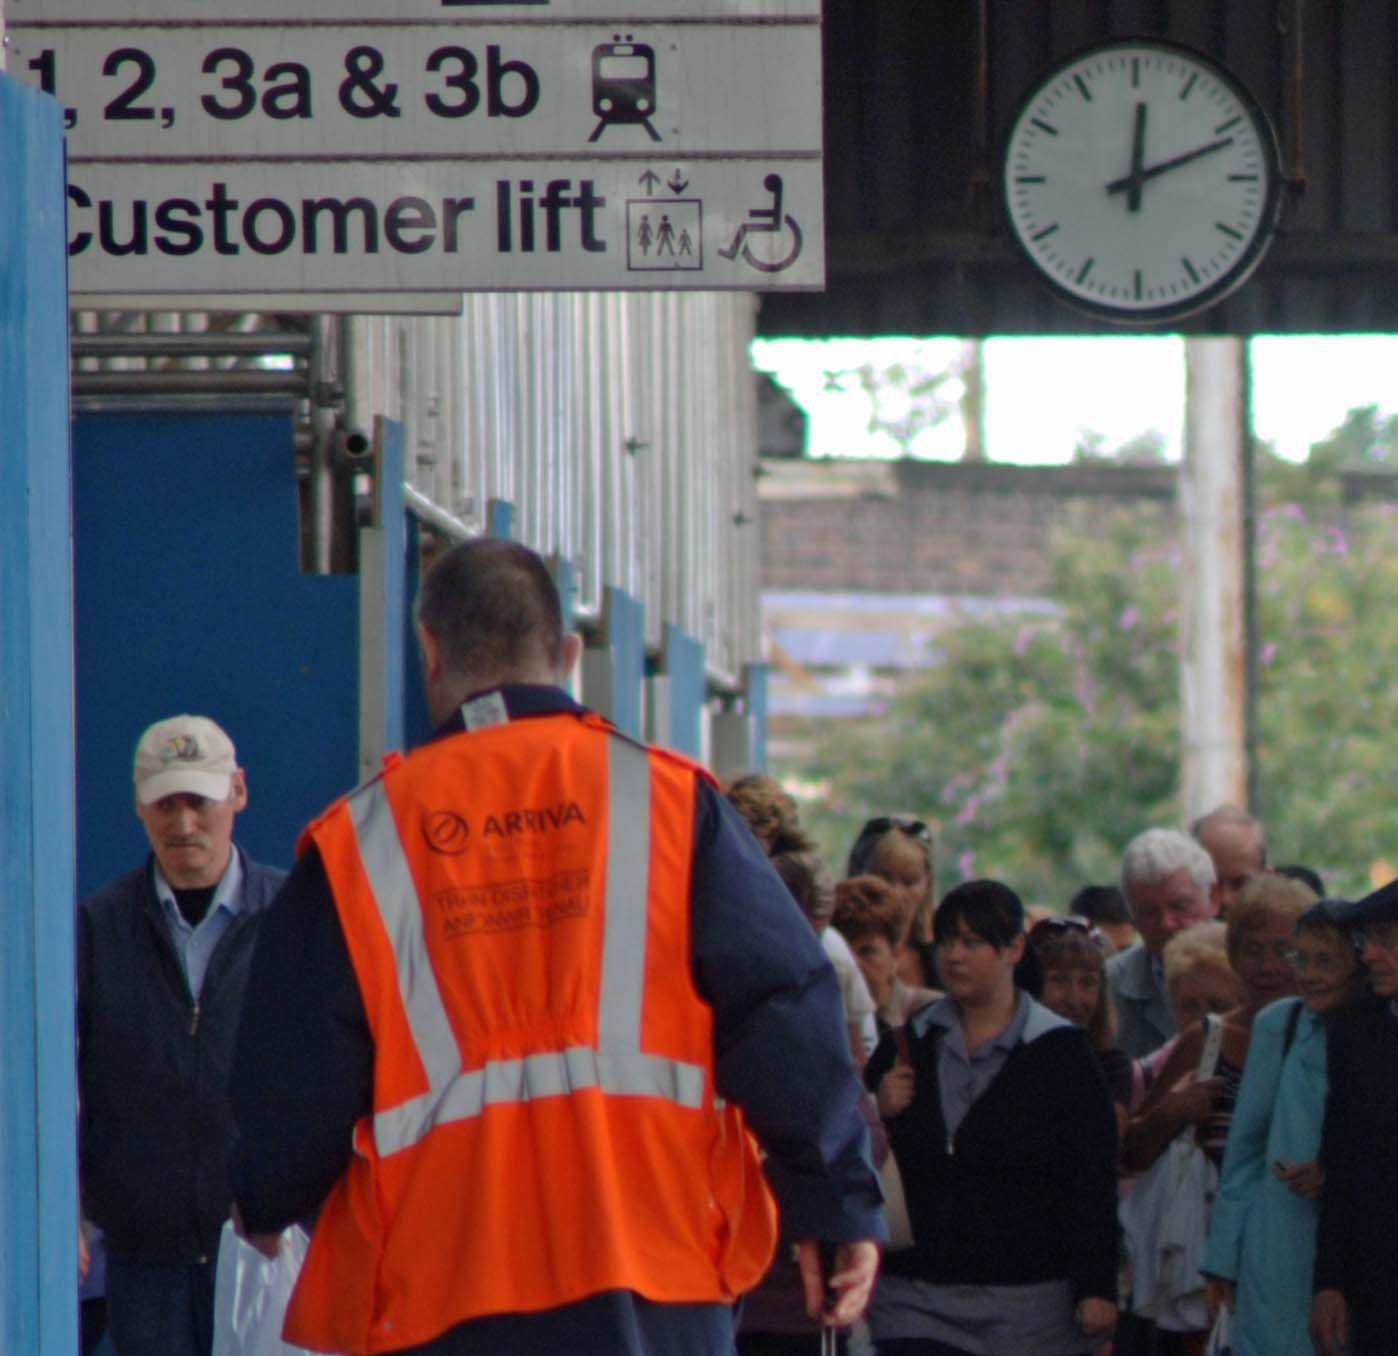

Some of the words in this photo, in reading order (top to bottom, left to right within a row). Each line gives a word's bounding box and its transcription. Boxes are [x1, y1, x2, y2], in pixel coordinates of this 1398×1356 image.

[27, 48, 79, 129] 1,
[101, 47, 176, 129] 2,
[200, 47, 314, 120] 3a
[337, 45, 402, 119] &
[424, 45, 541, 119] 3b
[495, 178, 607, 254] lift
[483, 801, 587, 839] ARRIVA
